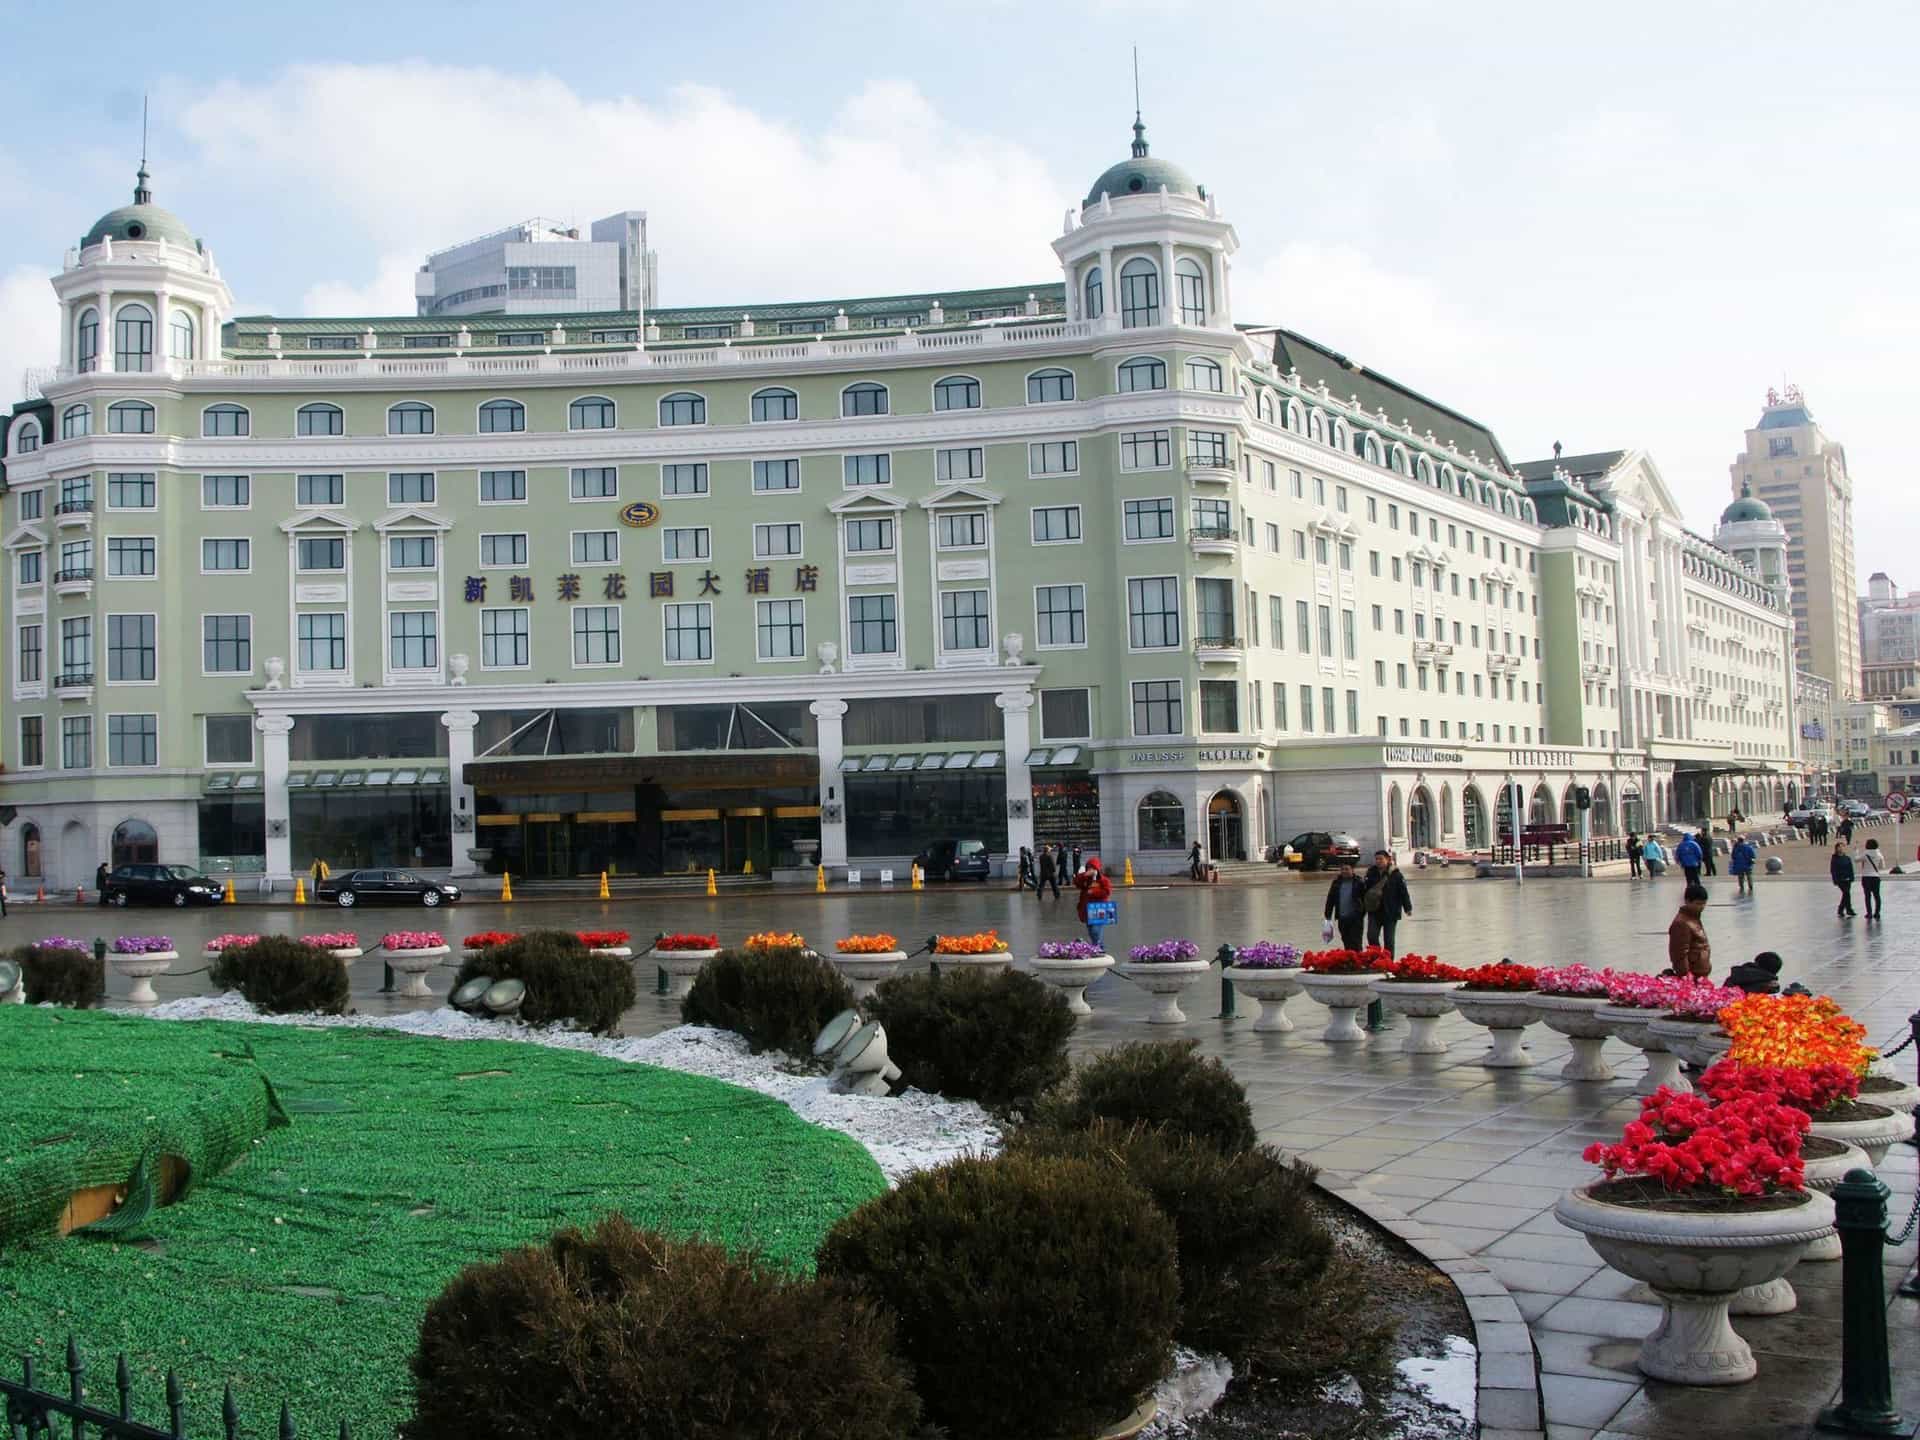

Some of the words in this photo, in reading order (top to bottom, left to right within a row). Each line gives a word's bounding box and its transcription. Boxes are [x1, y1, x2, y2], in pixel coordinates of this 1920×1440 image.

[464, 564, 819, 603] 新凯莱花园大酒店
